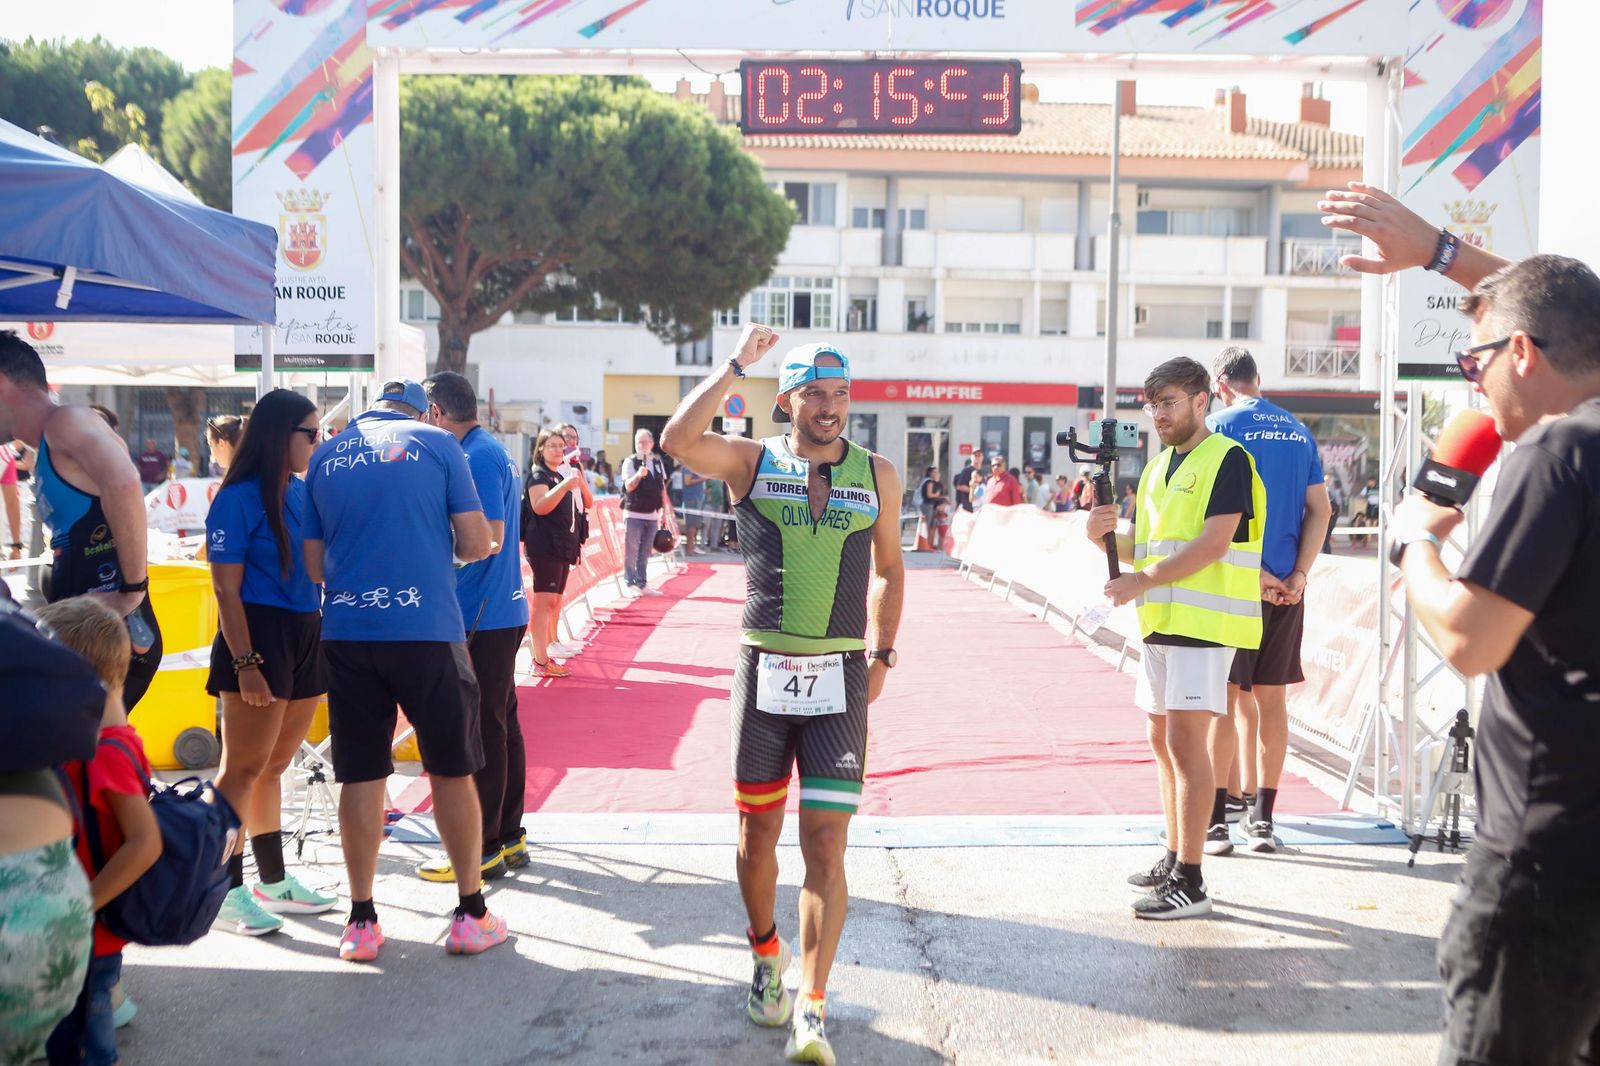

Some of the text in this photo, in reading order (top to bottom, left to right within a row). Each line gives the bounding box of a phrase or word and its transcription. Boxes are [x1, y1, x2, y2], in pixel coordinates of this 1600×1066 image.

[275, 286, 346, 301] AN ROQUE
[1427, 296, 1457, 310] SAN
[906, 385, 983, 399] MAPFRE
[1252, 413, 1292, 424] OFICIAL
[335, 432, 402, 453] OFICIAL
[783, 675, 818, 697] 47
